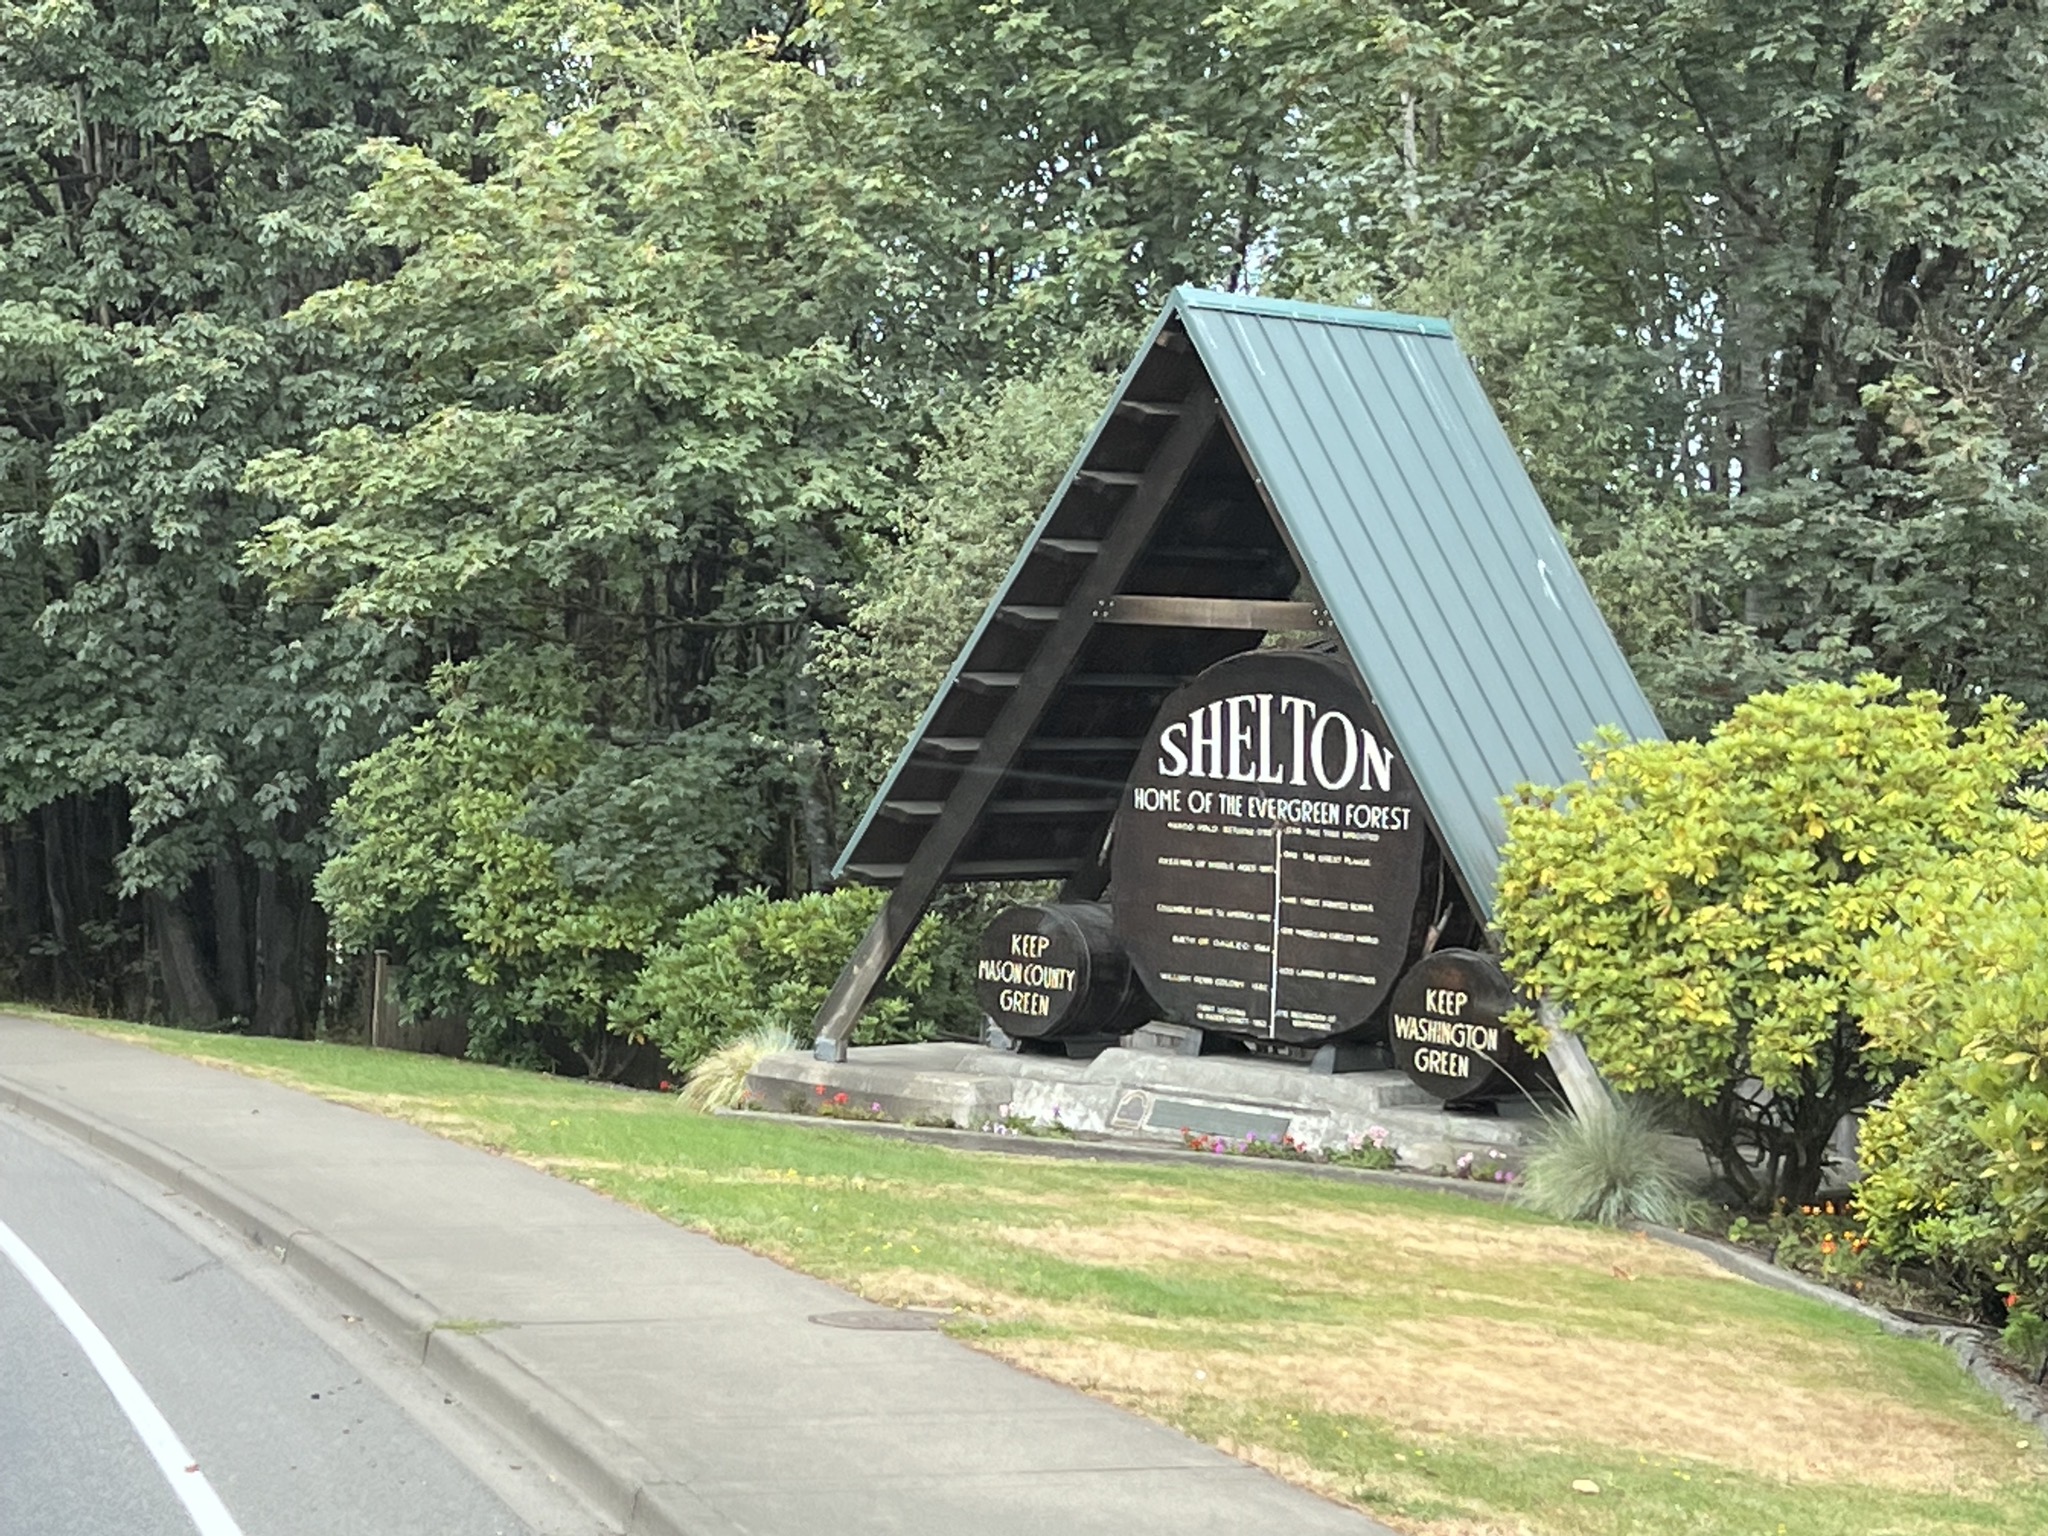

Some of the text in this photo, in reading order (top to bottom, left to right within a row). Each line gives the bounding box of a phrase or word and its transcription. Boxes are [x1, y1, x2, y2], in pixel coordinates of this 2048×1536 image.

[1157, 693, 1395, 792] SHELTON
[1133, 787, 1411, 830] HOME OF THE EVERGREEN FOREST
[1010, 933, 1050, 958] KEEP
[978, 959, 1075, 991] MASON COUNTY
[999, 989, 1050, 1016] GREEN
[1425, 988, 1468, 1016] KEEP
[1393, 1013, 1498, 1051] WASHINGTON
[1413, 1047, 1470, 1078] GREEN
